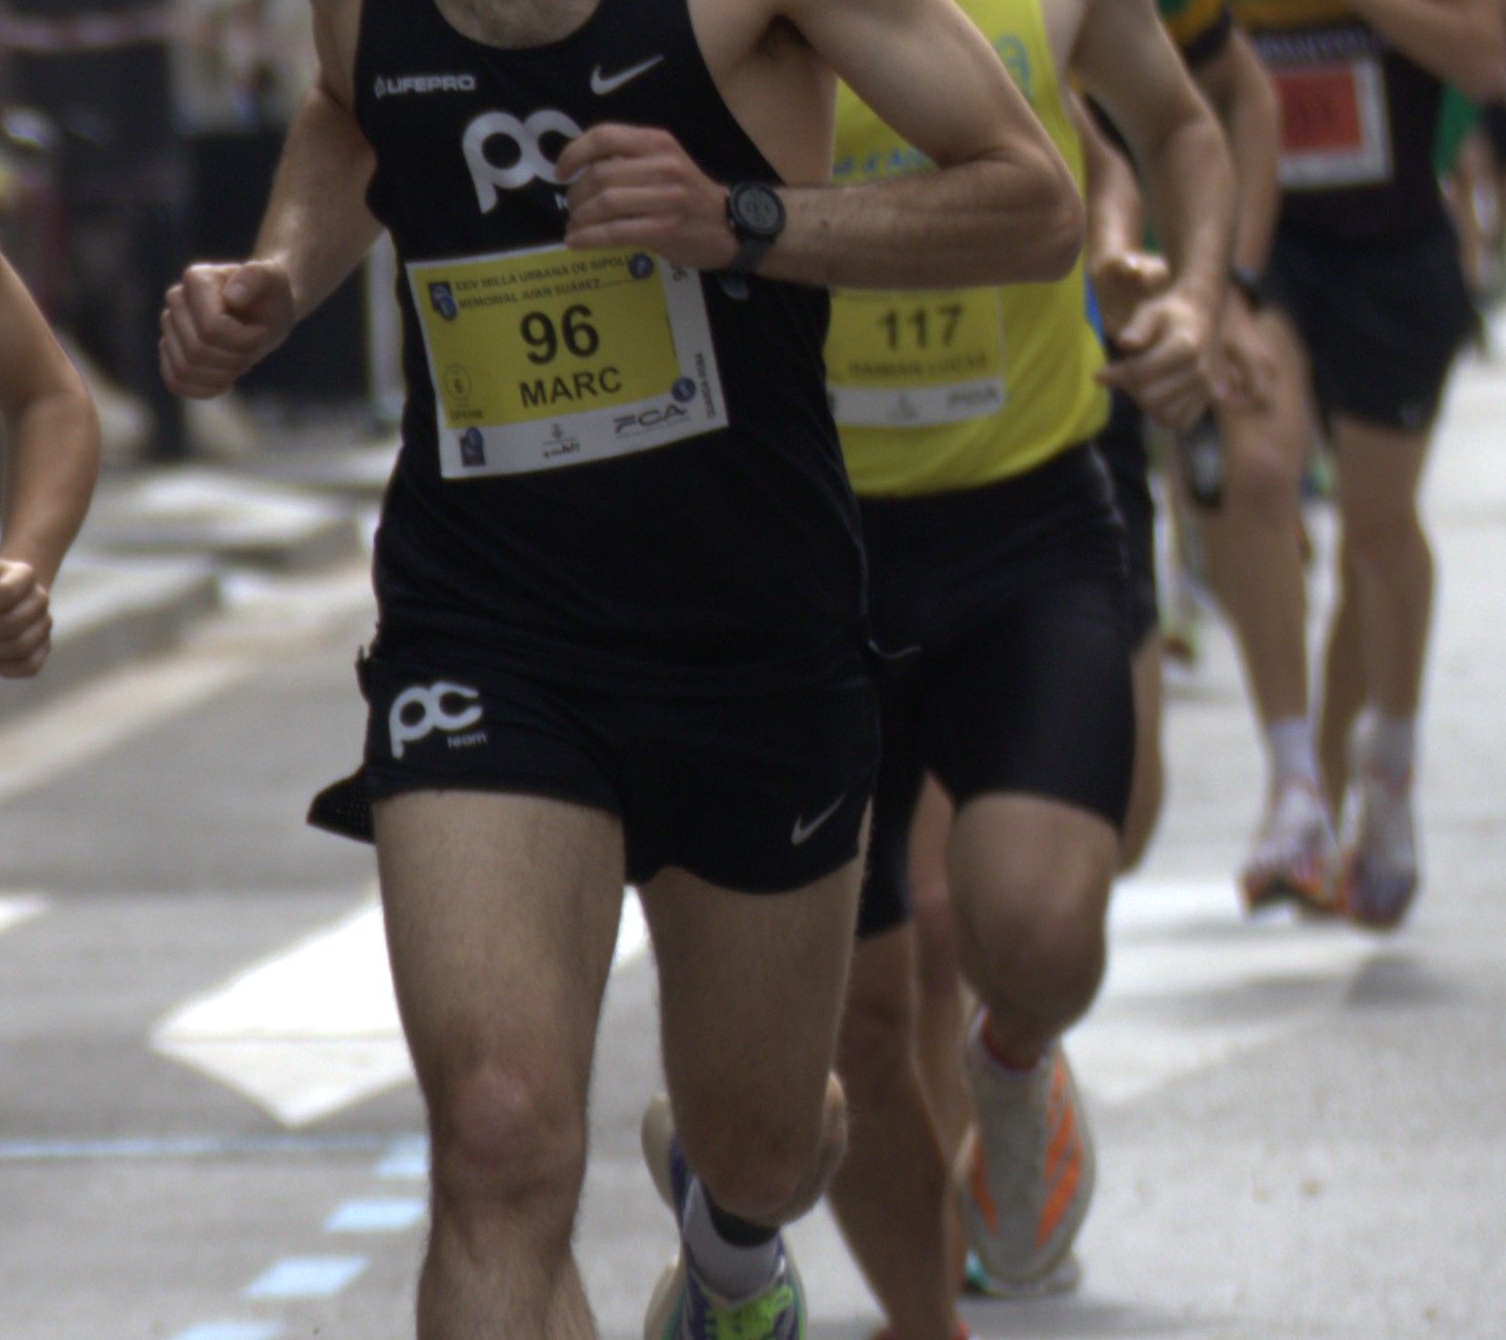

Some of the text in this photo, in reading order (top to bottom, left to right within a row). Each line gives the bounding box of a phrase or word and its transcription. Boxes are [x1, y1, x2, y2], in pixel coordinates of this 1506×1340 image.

[386, 75, 477, 94] LIFEPRO
[480, 273, 518, 289] MILLA
[519, 264, 571, 284] URBANA
[572, 263, 587, 275] DE
[458, 292, 517, 310] MEMORIAL
[521, 287, 552, 301] JUAN
[519, 303, 601, 366] 96
[878, 303, 964, 352] 117
[519, 366, 623, 408] MARC
